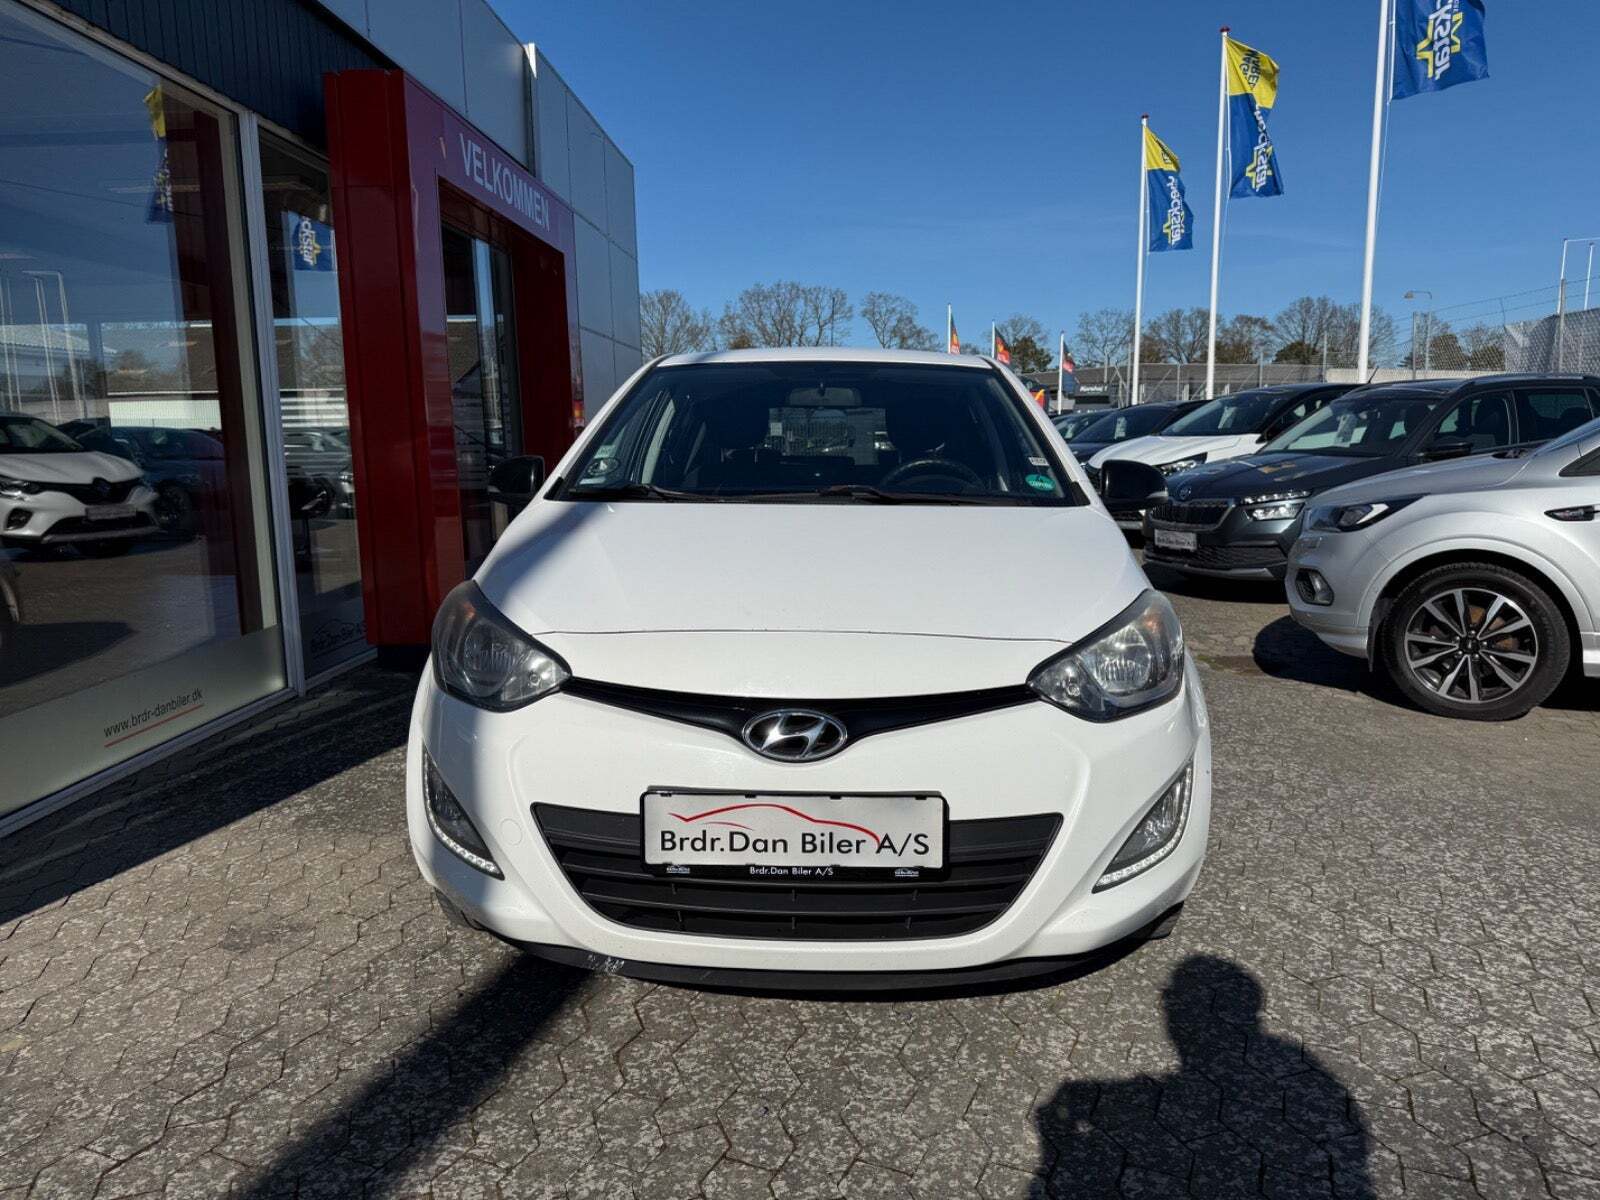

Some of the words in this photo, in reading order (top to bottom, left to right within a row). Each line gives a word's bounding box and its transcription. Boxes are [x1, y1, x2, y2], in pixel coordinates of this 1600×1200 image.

[459, 133, 550, 232] VELKOMMEN
[103, 688, 204, 737] www.brdr-danbiler.dk
[660, 829, 789, 853] Brdr.Dan
[801, 831, 867, 854] Biler
[875, 832, 930, 857] A/S
[749, 866, 789, 876] Brdr.Dan
[791, 867, 812, 876] Biler
[815, 867, 834, 877] A/S
